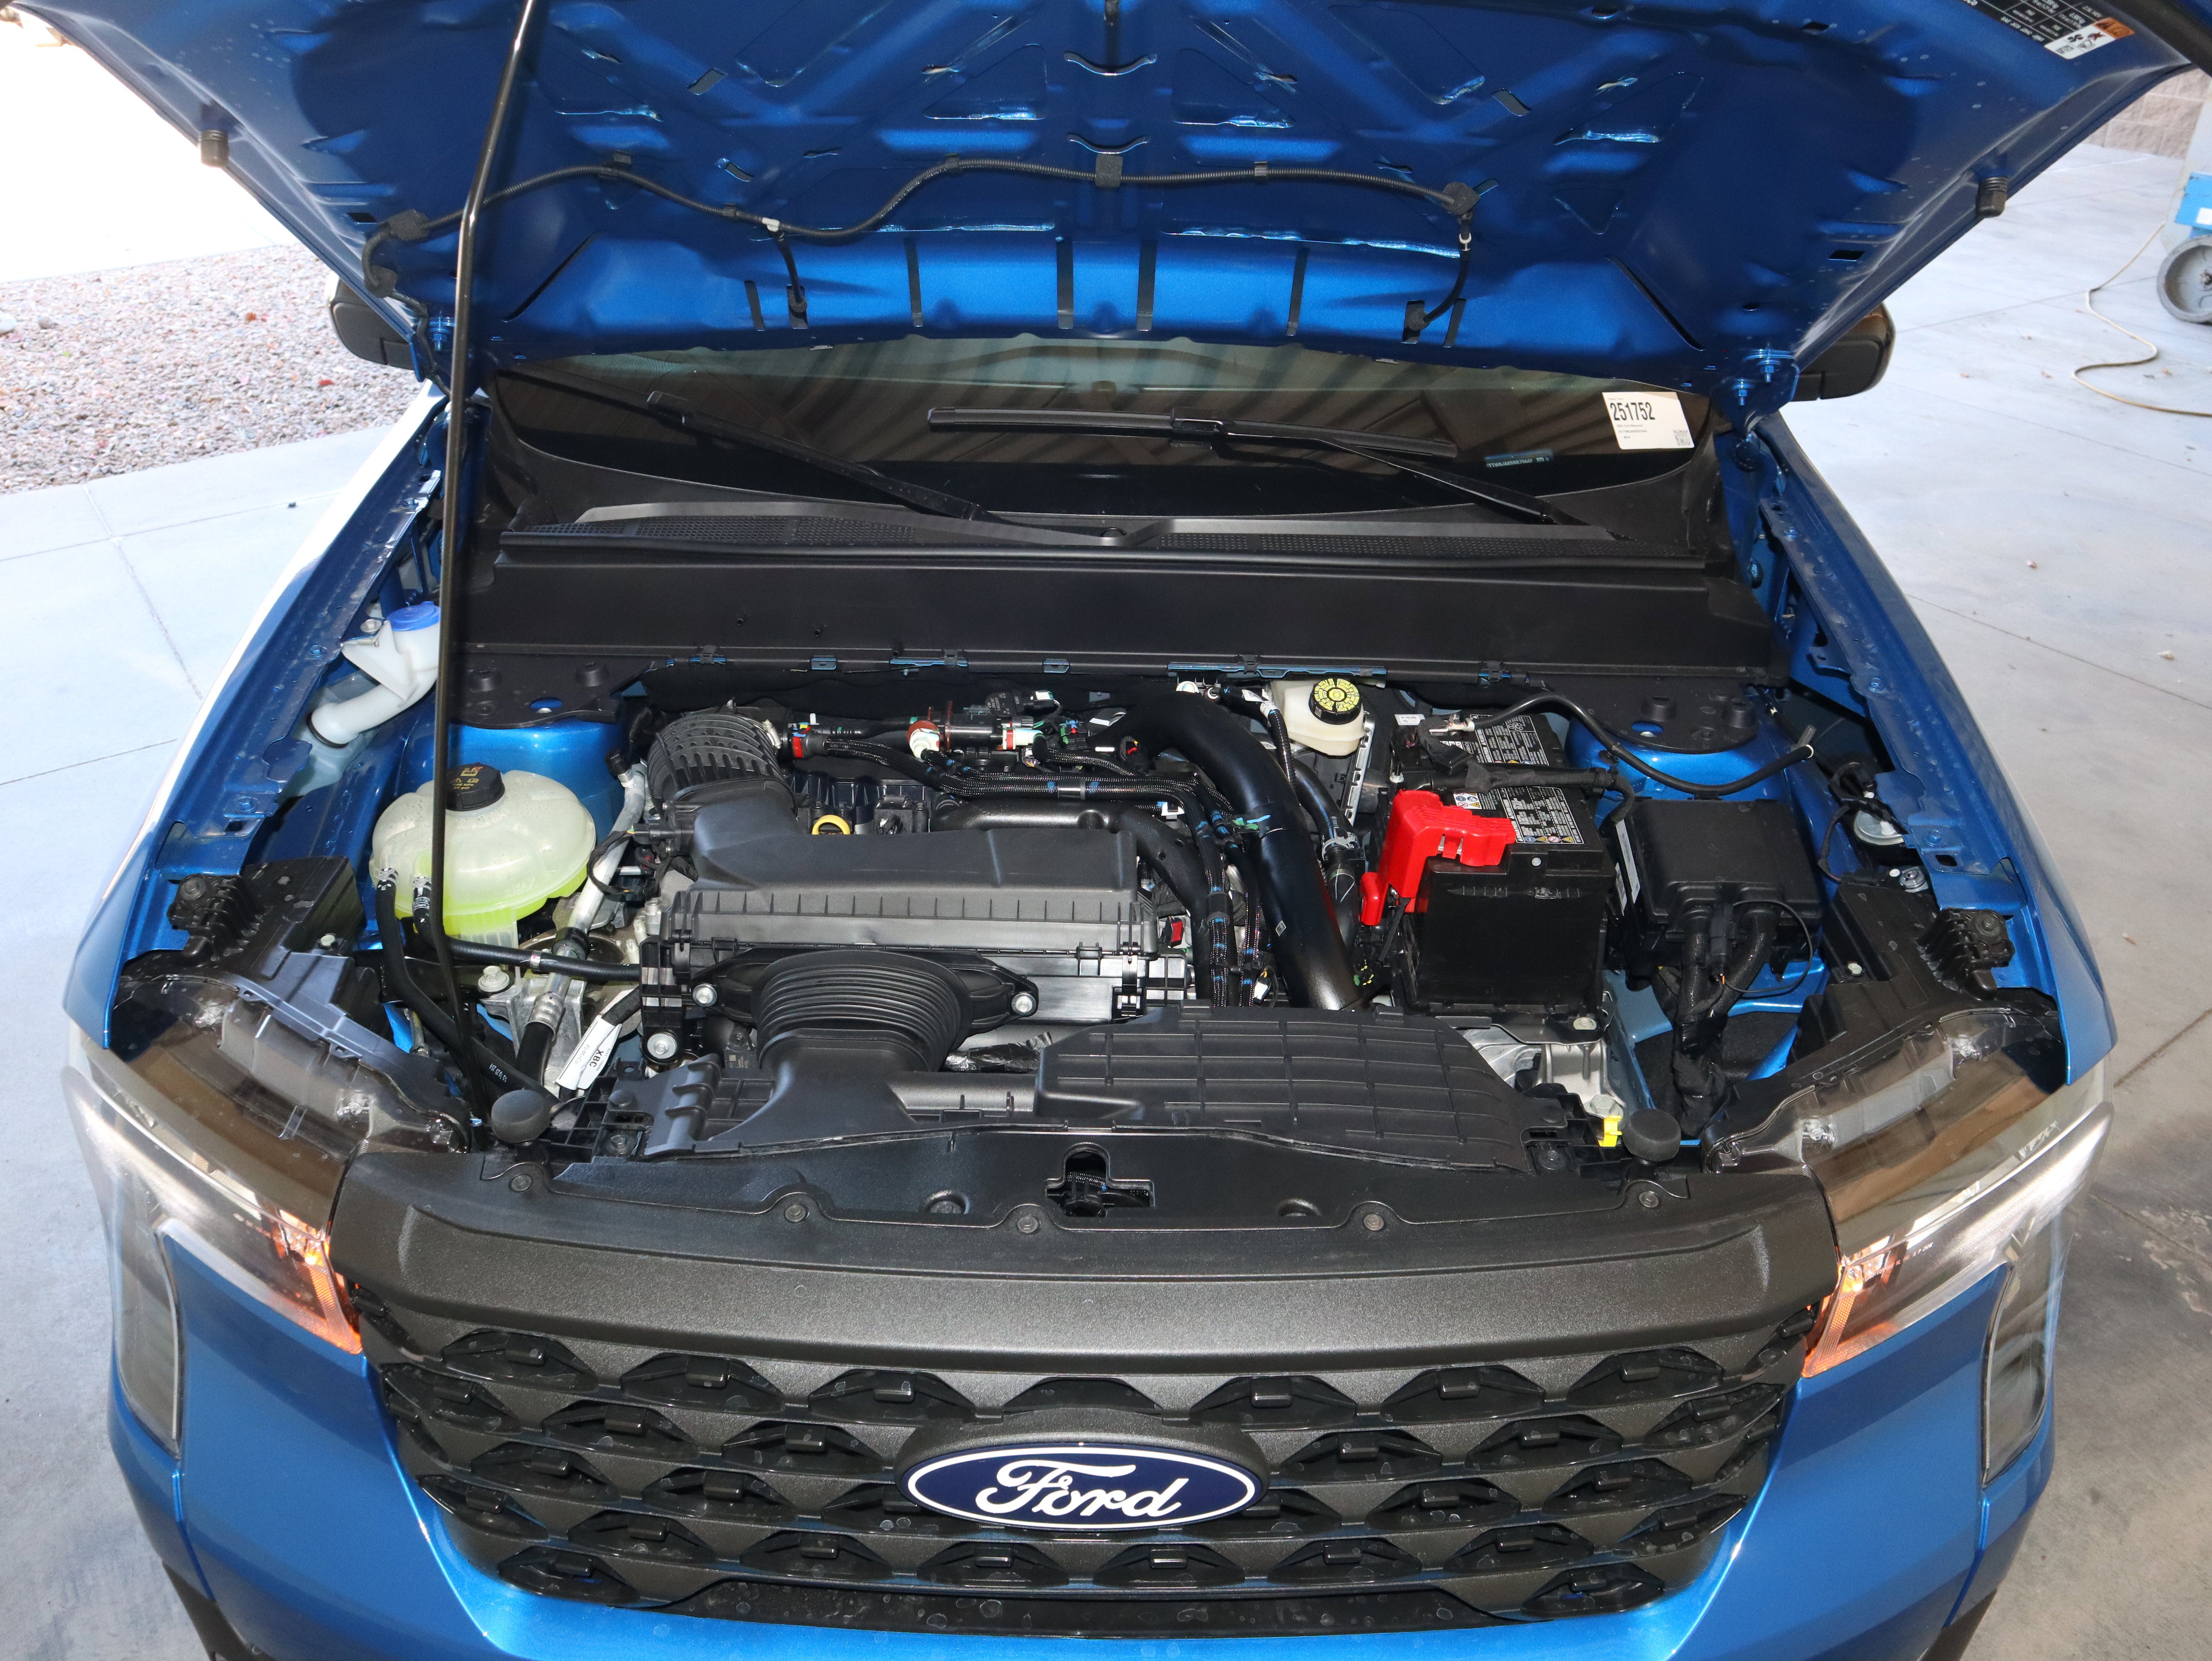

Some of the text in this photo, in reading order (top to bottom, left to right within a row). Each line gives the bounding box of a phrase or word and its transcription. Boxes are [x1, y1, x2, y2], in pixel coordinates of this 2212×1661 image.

[1610, 402, 1656, 421] 251752
[575, 1044, 590, 1064] FoMoCo
[589, 1049, 604, 1068] XBC
[975, 1459, 1189, 1516] Ford
